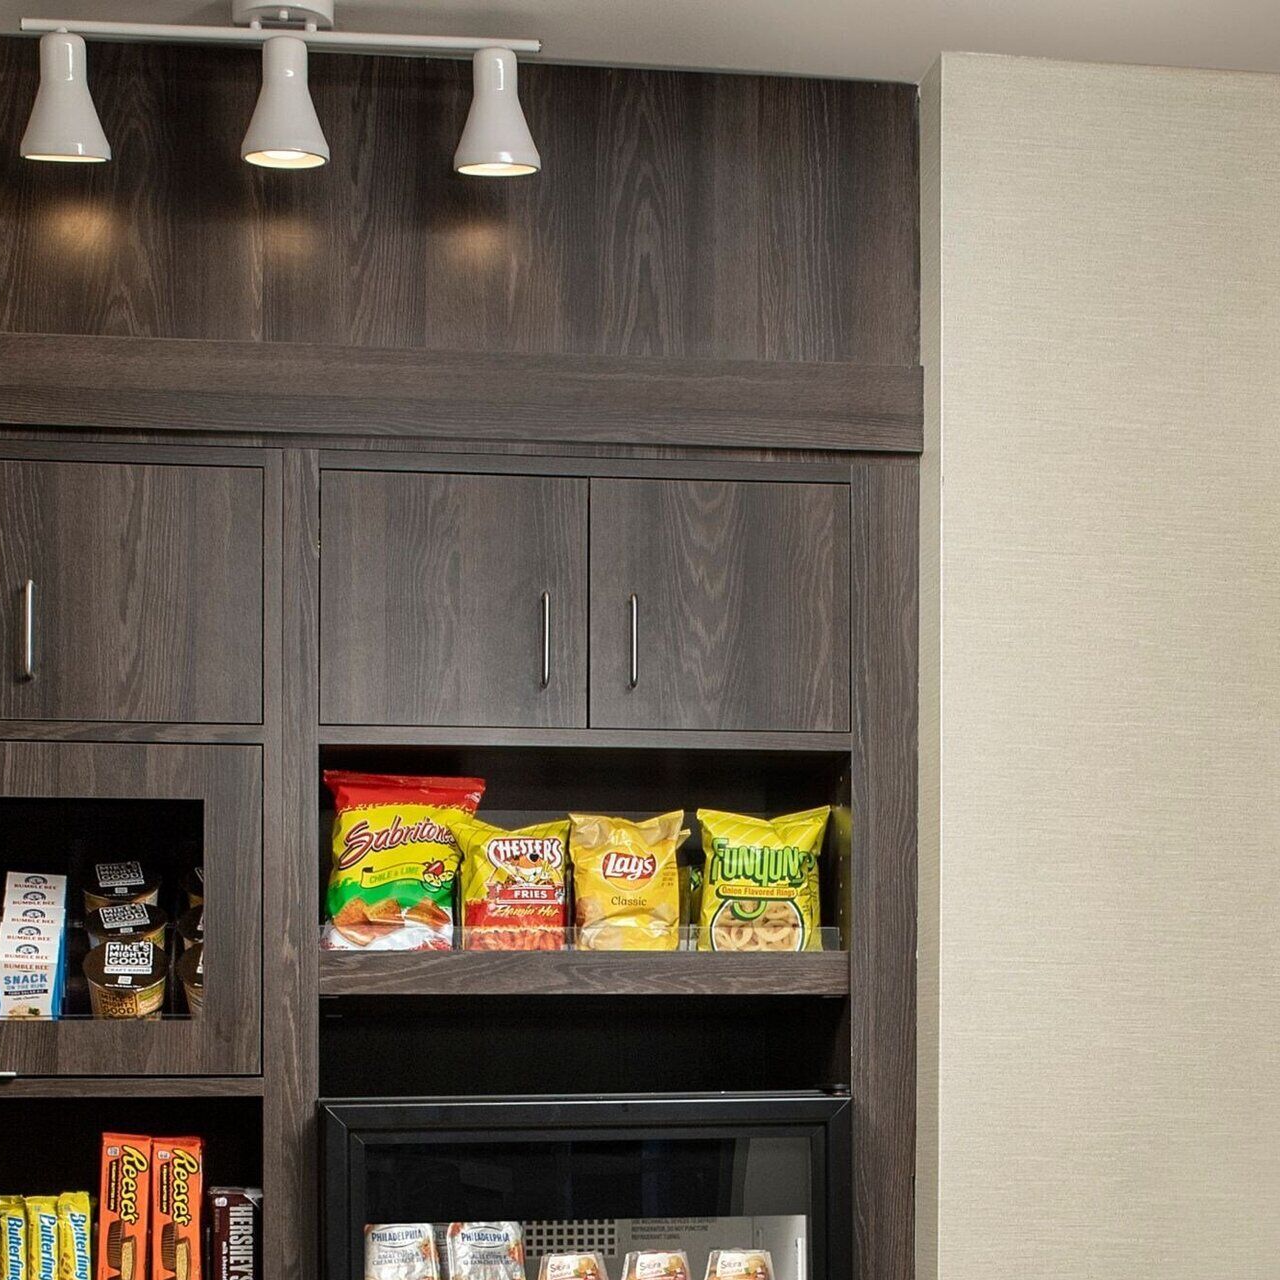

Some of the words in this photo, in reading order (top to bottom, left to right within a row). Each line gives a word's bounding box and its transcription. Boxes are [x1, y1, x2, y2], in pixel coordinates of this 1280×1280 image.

[513, 889, 548, 899] FRIES
[721, 885, 743, 896] Onion
[745, 886, 775, 896] Flavored
[777, 888, 795, 898] Rings
[611, 896, 647, 907] Classic
[106, 914, 144, 922] GOOD
[109, 942, 150, 952] MIKE'S
[109, 957, 148, 965] GOOD
[4, 974, 48, 985] SNACK
[121, 1144, 149, 1225] Reese's
[171, 1148, 200, 1227] Reese's
[372, 1230, 422, 1242] PHILADELPHIA
[462, 1231, 510, 1242] PHILADELPHIA
